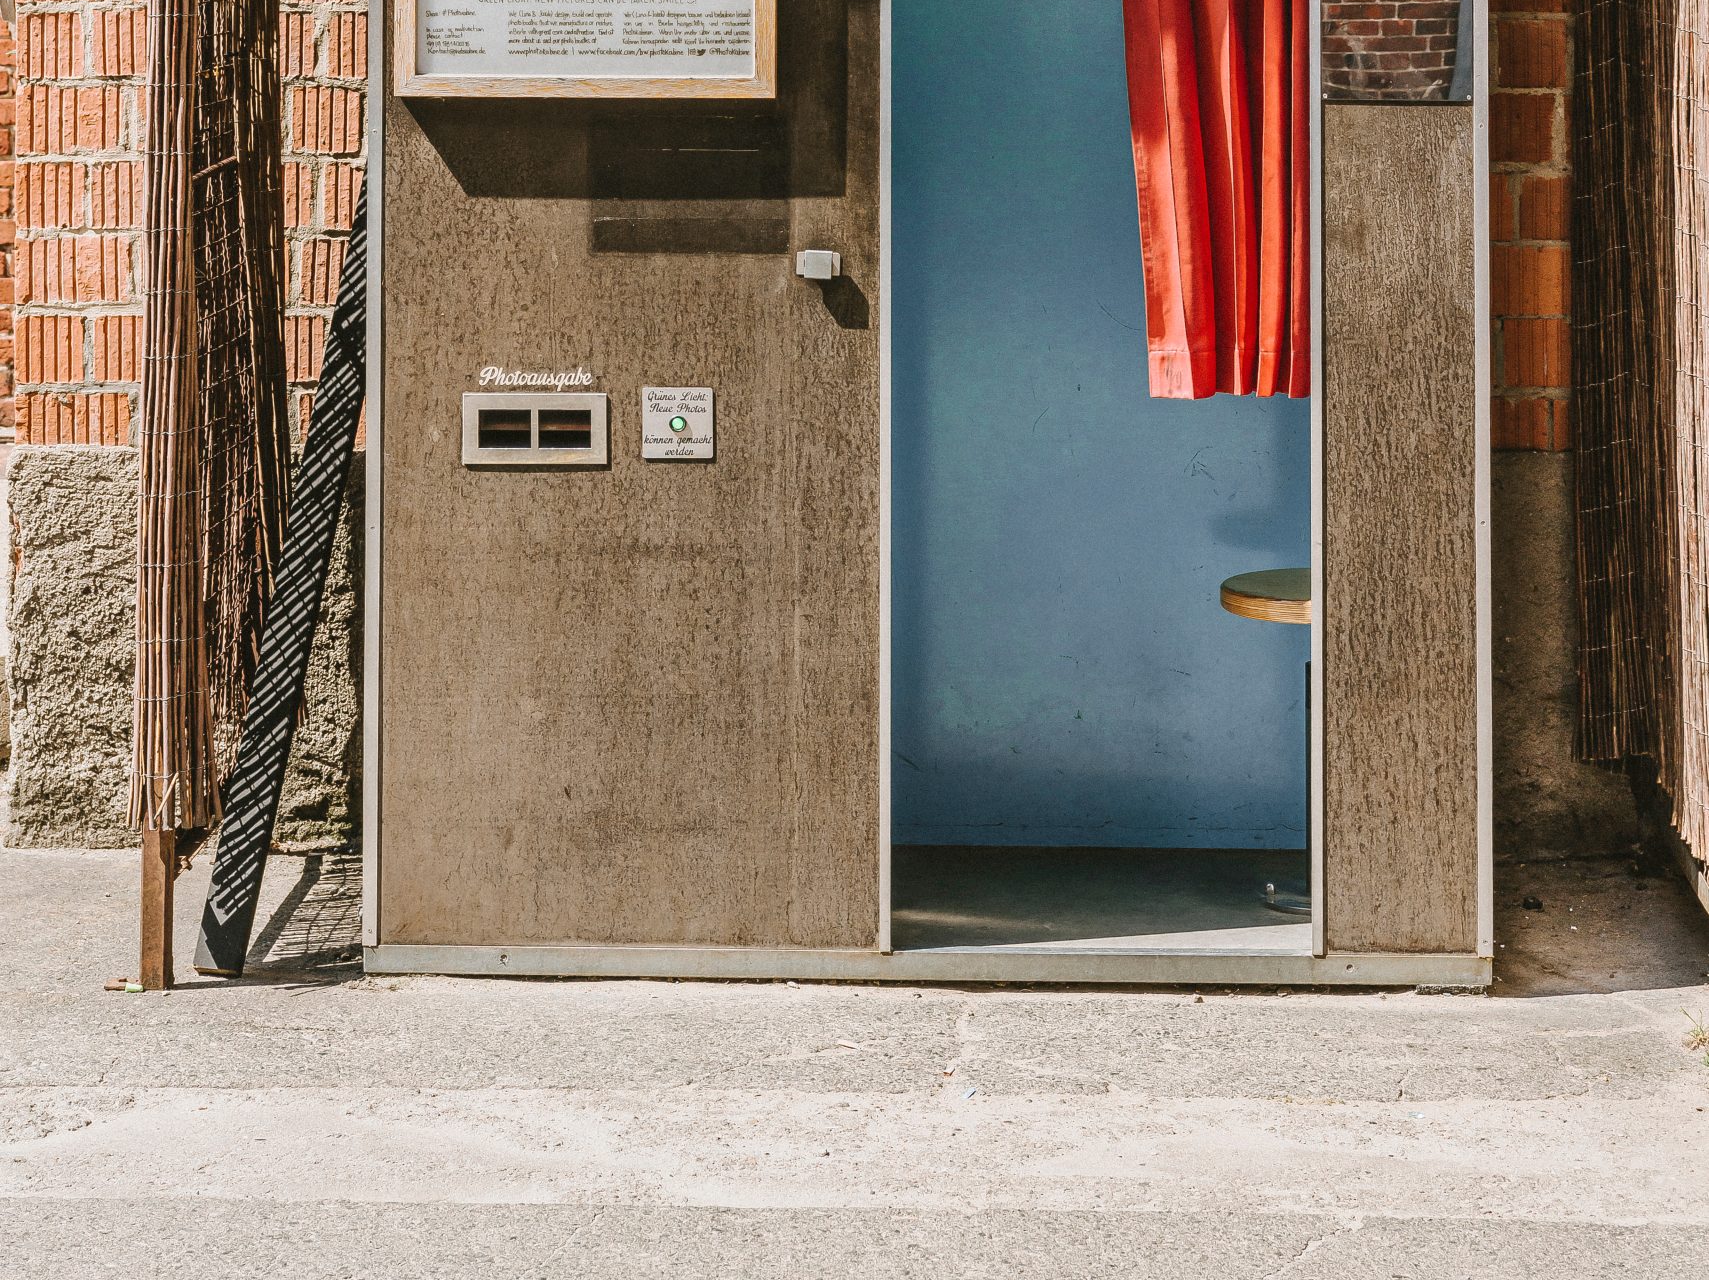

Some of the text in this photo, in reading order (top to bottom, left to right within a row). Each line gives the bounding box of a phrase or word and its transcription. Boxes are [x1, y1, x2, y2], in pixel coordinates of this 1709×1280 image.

[478, 366, 593, 392] Photoausgabe
[647, 390, 677, 402] Grünes
[649, 402, 707, 413] Neue Photos
[643, 434, 713, 447] können gemacht
[664, 446, 695, 456] werden
